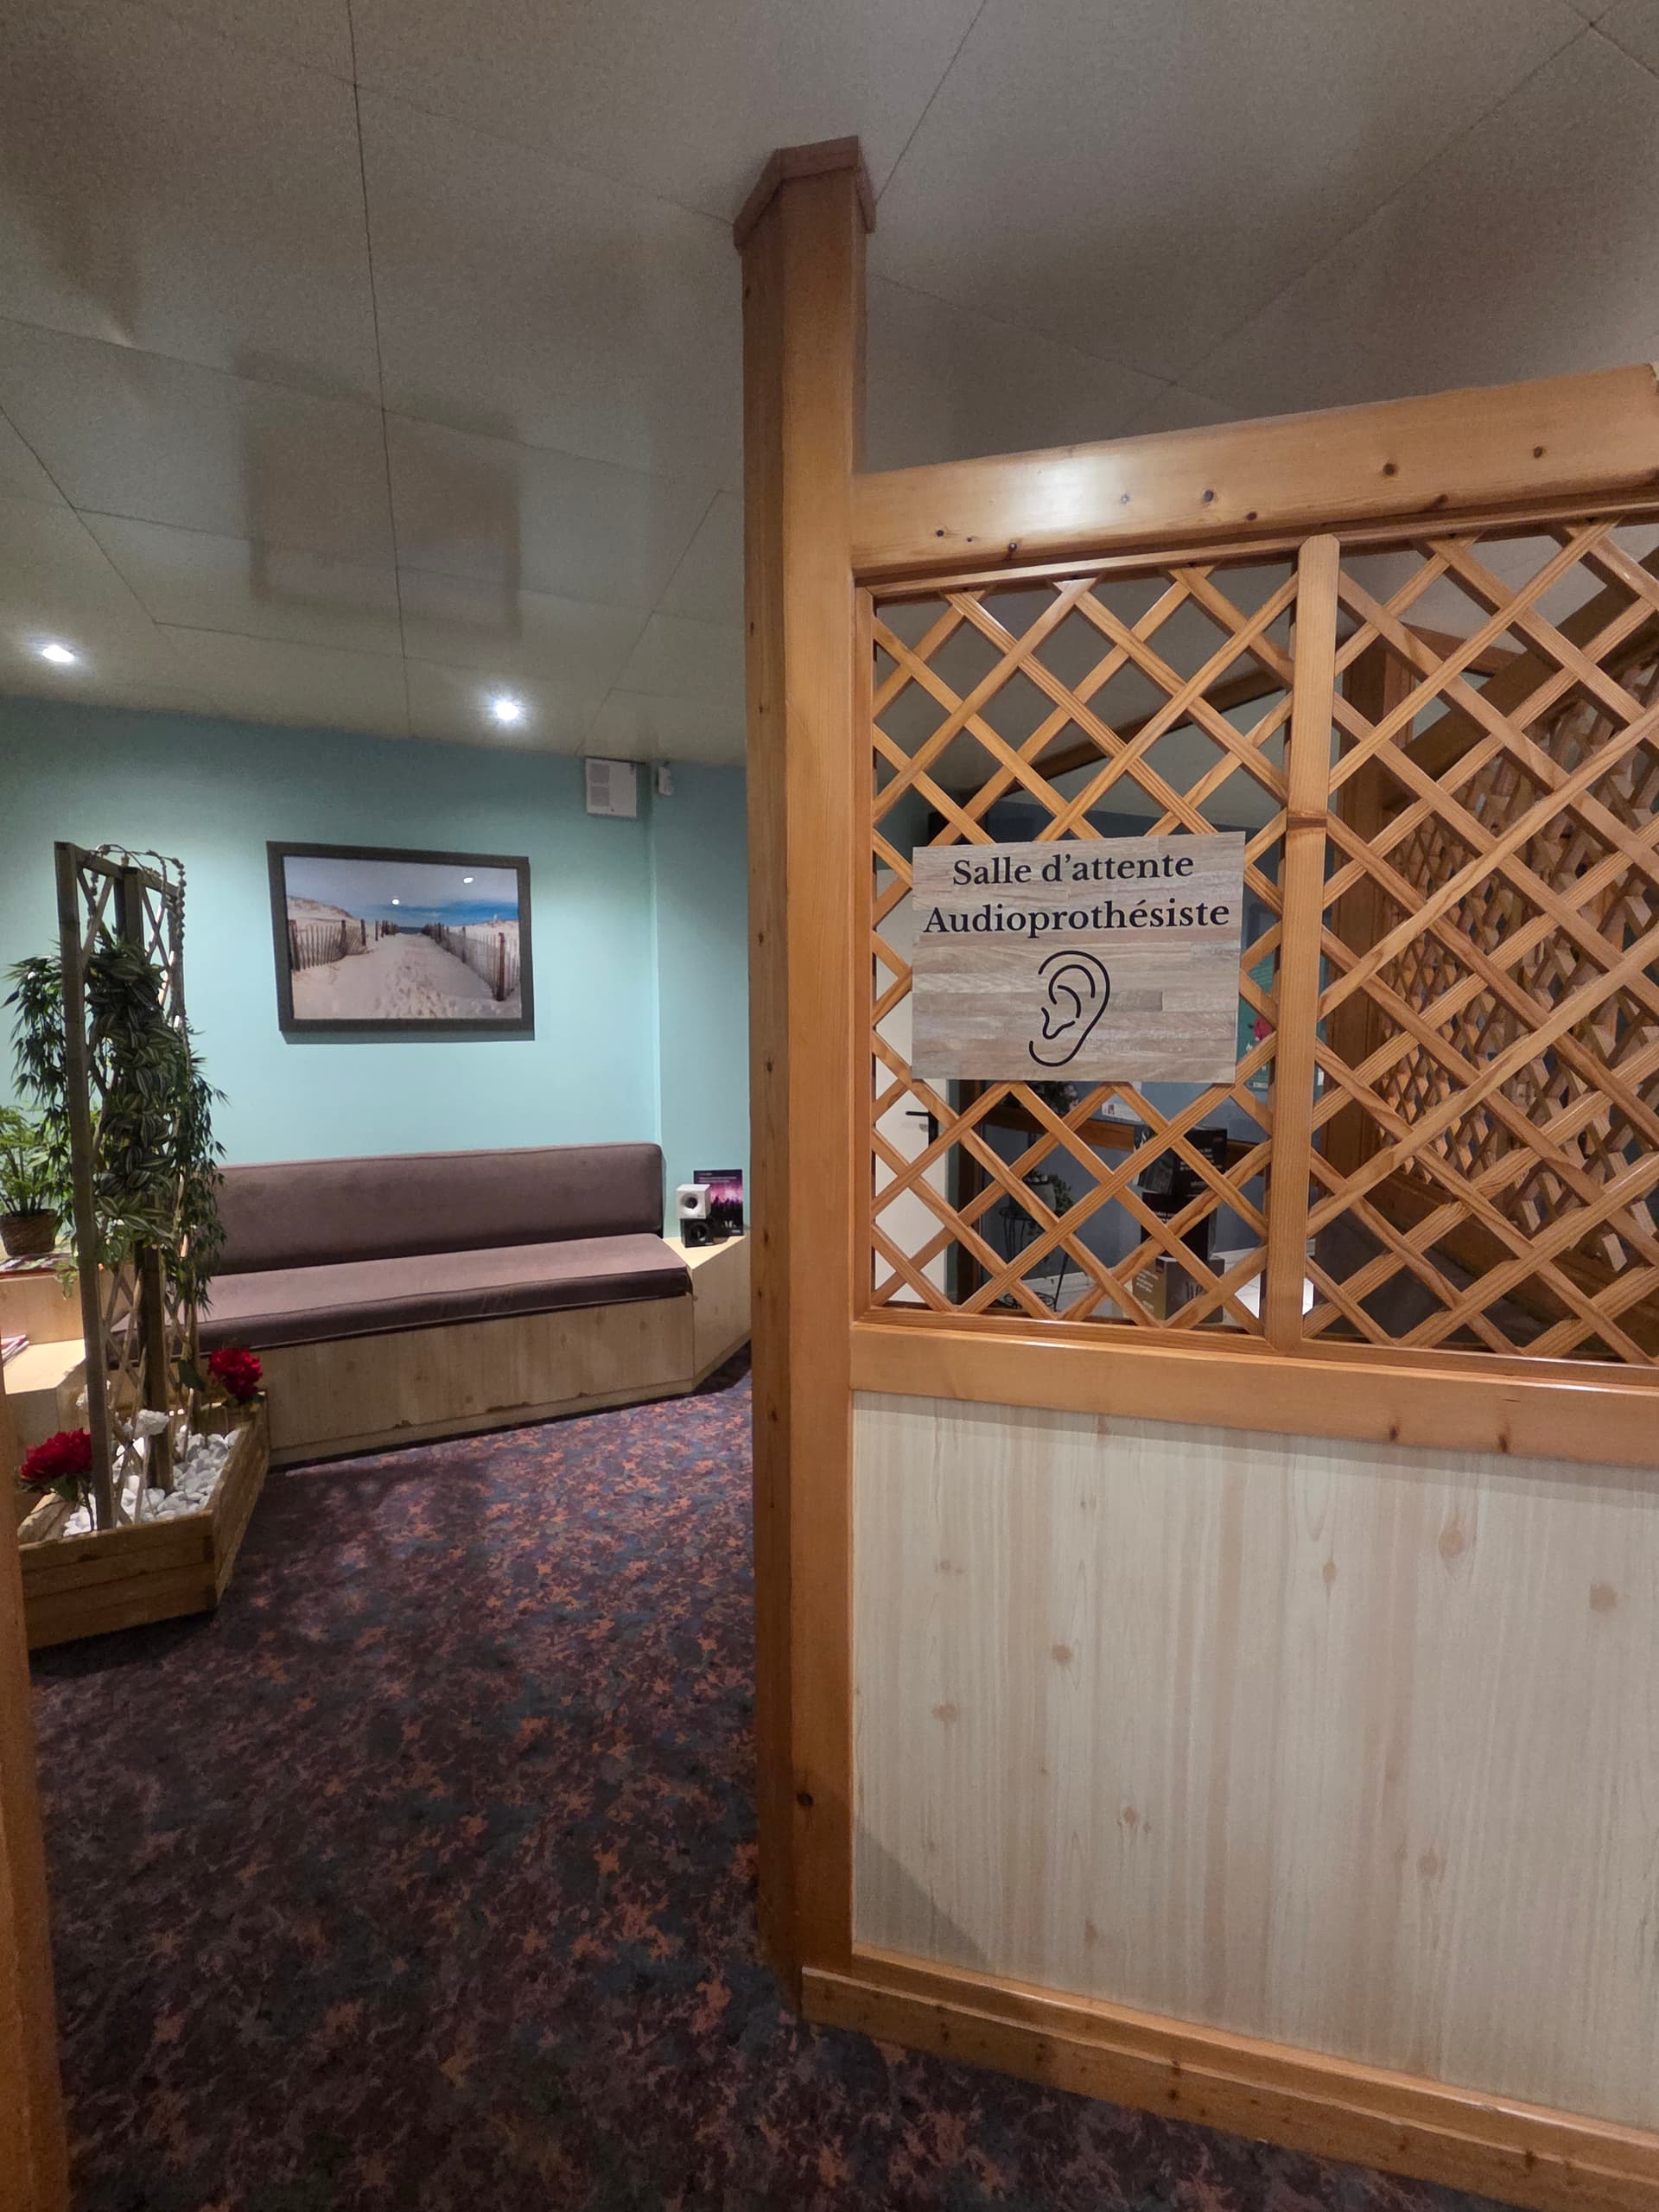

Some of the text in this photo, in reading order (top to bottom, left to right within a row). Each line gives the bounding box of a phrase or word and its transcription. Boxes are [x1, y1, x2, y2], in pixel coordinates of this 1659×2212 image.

[953, 854, 1194, 886] Salle d’attente
[923, 898, 1230, 938] Audioprothésiste
